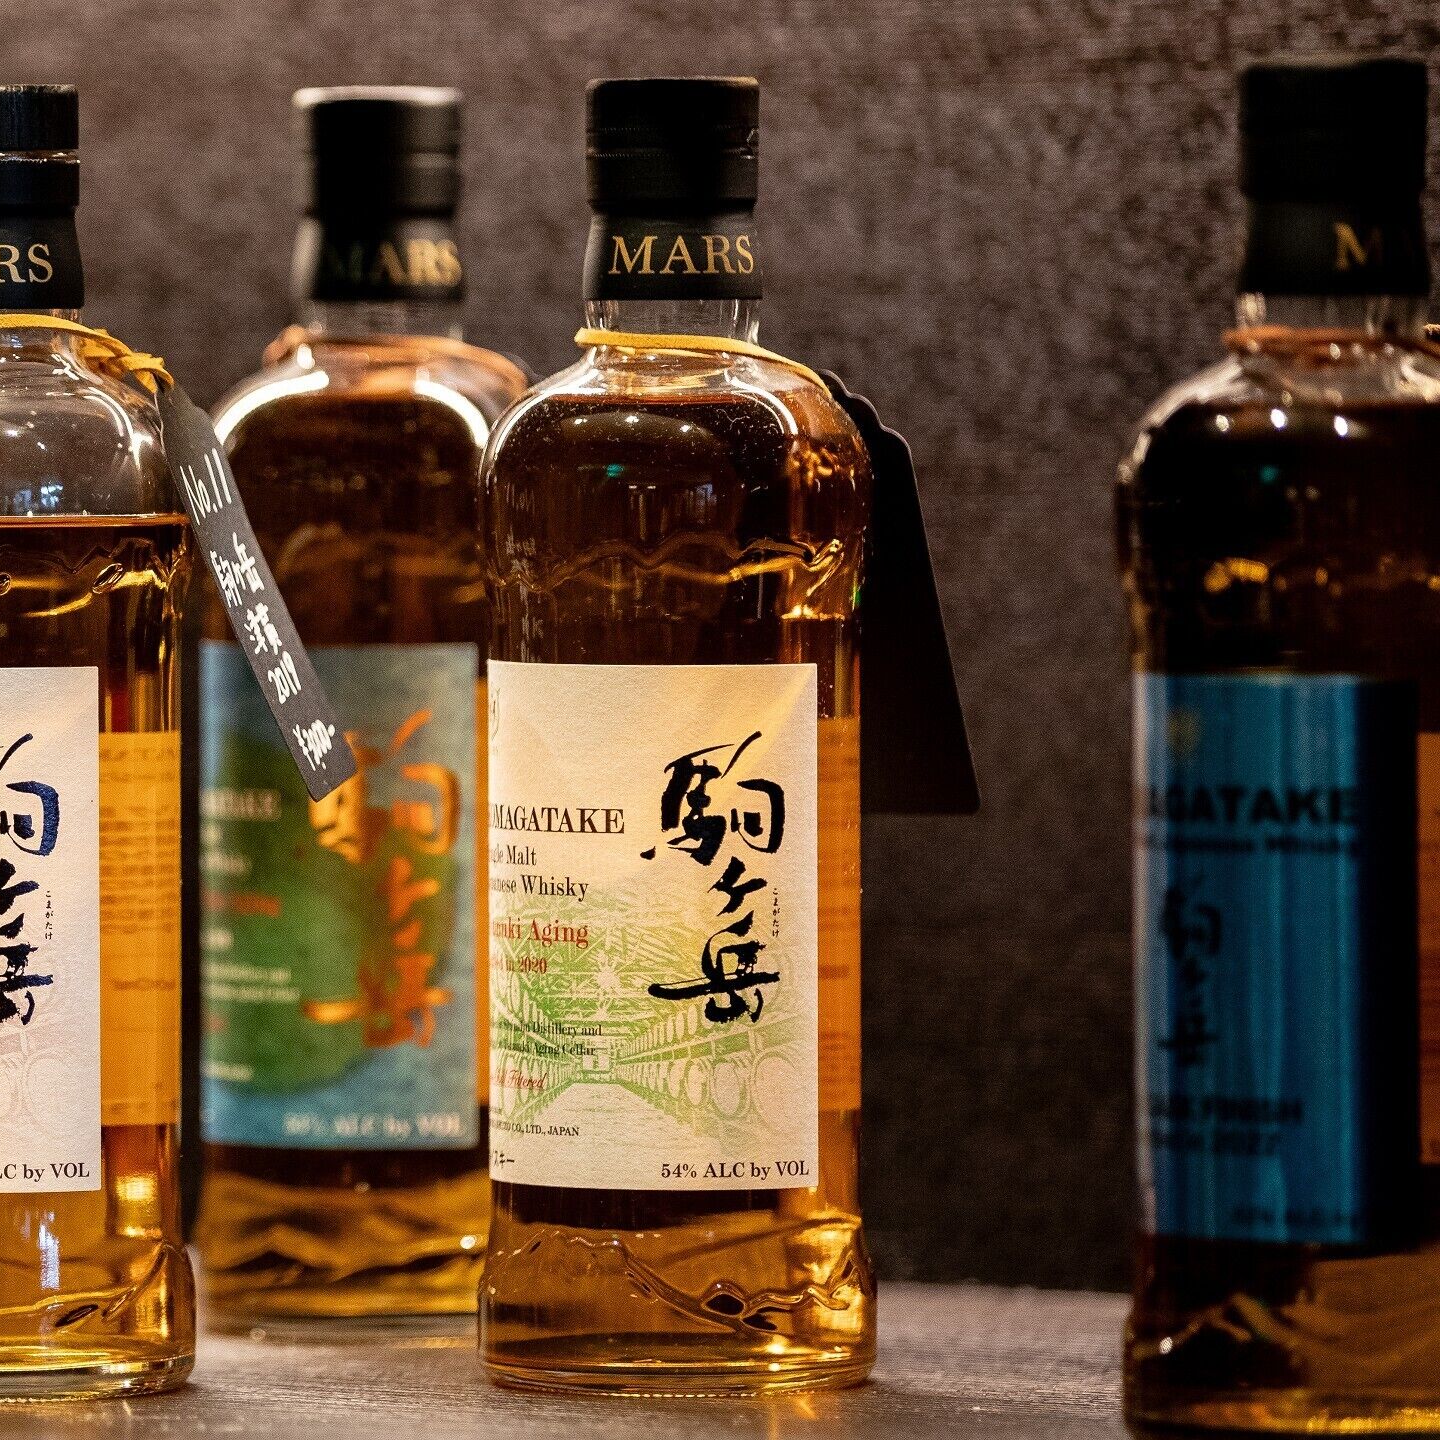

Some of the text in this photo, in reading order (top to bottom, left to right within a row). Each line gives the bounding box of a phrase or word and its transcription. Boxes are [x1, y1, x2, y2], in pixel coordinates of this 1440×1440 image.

[609, 234, 754, 274] MARS
[179, 447, 232, 526] No.11
[267, 650, 302, 704] 2019
[506, 845, 537, 866] Malt
[520, 874, 589, 902] Whisky
[527, 918, 589, 949] Aging
[517, 955, 548, 975] 2020
[532, 1021, 578, 1039] Distillery
[581, 1024, 602, 1037] and
[533, 1042, 560, 1058] Aging
[562, 1042, 596, 1057] Cellar
[547, 1126, 580, 1138] JAPAN
[22, 1163, 45, 1183] by
[52, 1161, 91, 1179] VOL
[660, 1160, 810, 1182] 54% ALC by VOL
